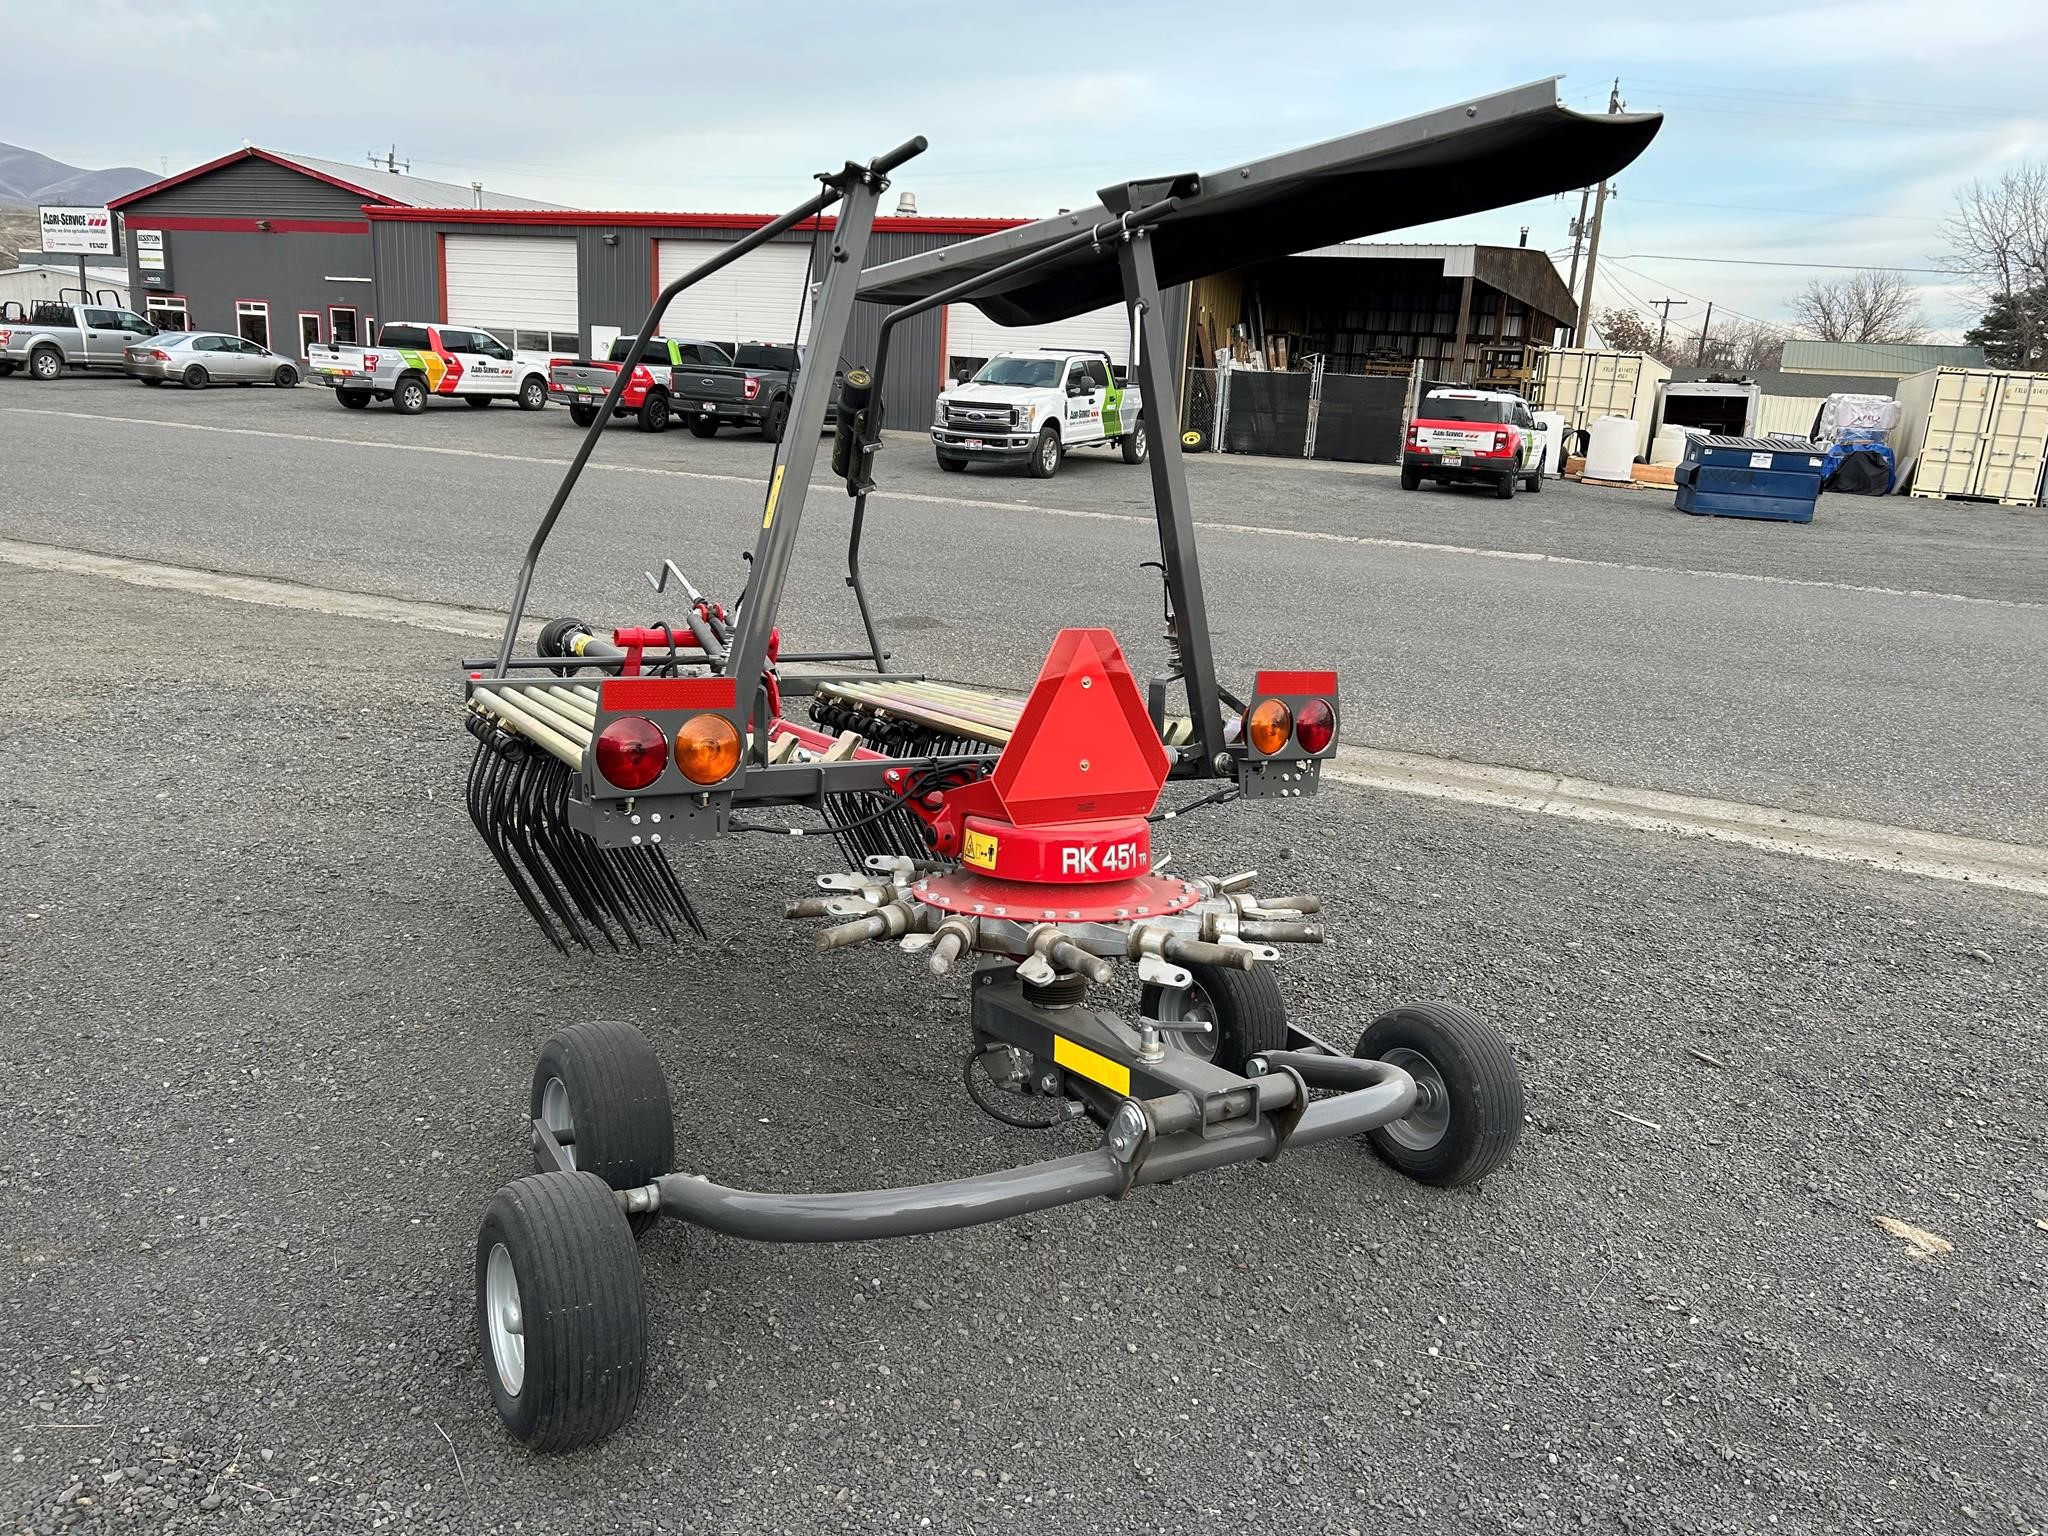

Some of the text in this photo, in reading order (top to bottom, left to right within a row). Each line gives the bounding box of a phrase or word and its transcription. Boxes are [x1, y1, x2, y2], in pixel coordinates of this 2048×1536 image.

[43, 213, 86, 225] AGRI-SERVICE
[1062, 846, 1099, 874] RK
[1102, 842, 1137, 871] 451
